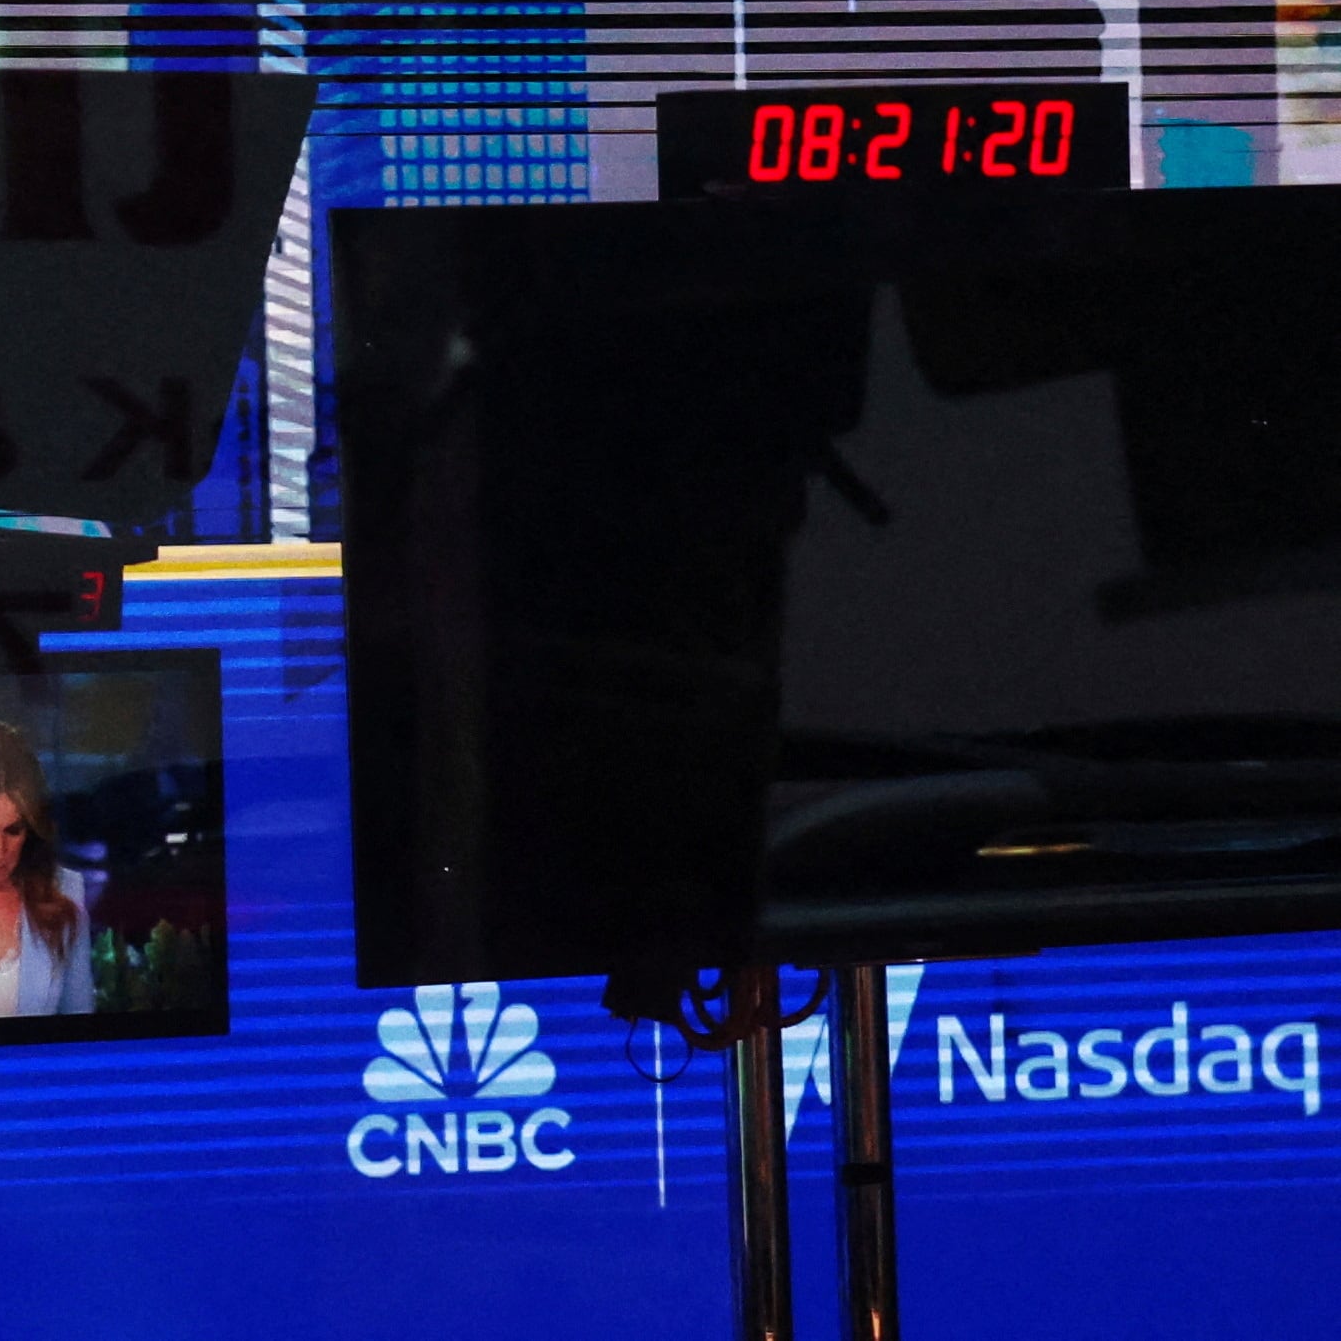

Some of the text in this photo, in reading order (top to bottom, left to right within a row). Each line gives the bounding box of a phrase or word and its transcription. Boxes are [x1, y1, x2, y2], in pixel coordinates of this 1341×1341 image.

[749, 99, 1075, 182] 08:21:20
[937, 1001, 1319, 1116] Nasdaq
[346, 1106, 576, 1178] CNBC
